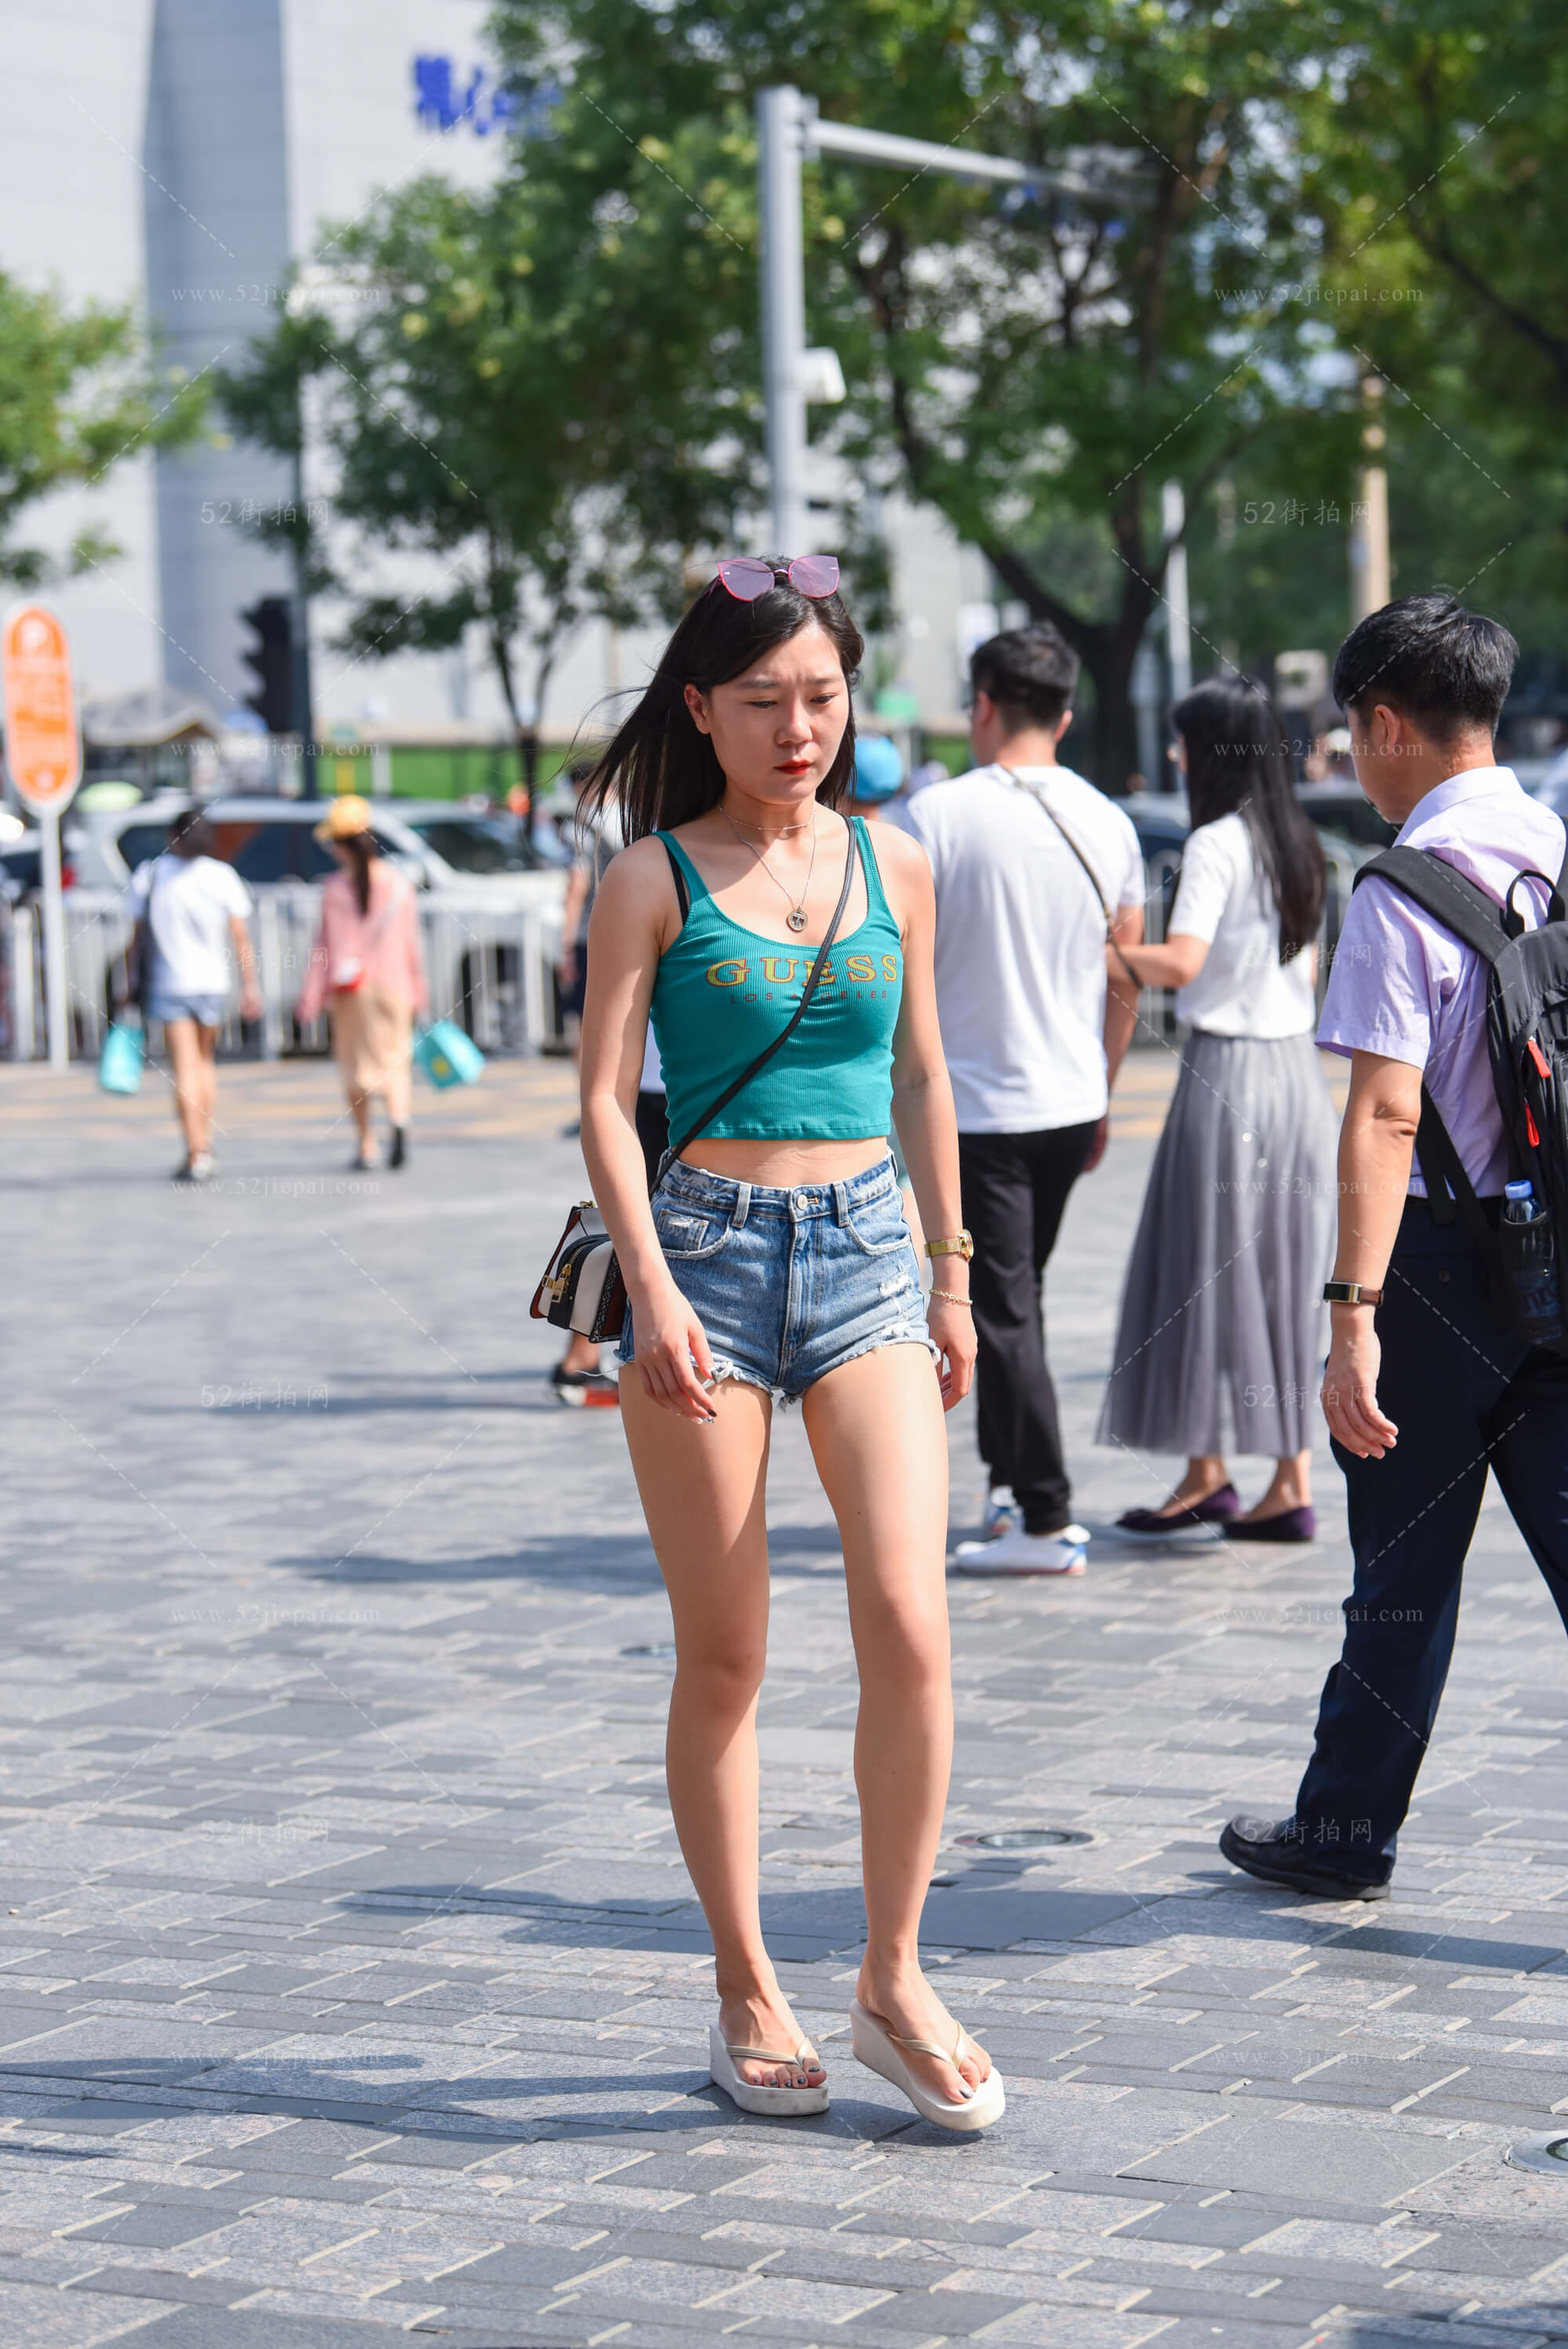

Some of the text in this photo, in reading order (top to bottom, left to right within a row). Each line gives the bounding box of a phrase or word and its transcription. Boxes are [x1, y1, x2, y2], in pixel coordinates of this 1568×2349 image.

[706, 954, 898, 987] GUESS
[731, 989, 887, 1004] LOS AGELES
